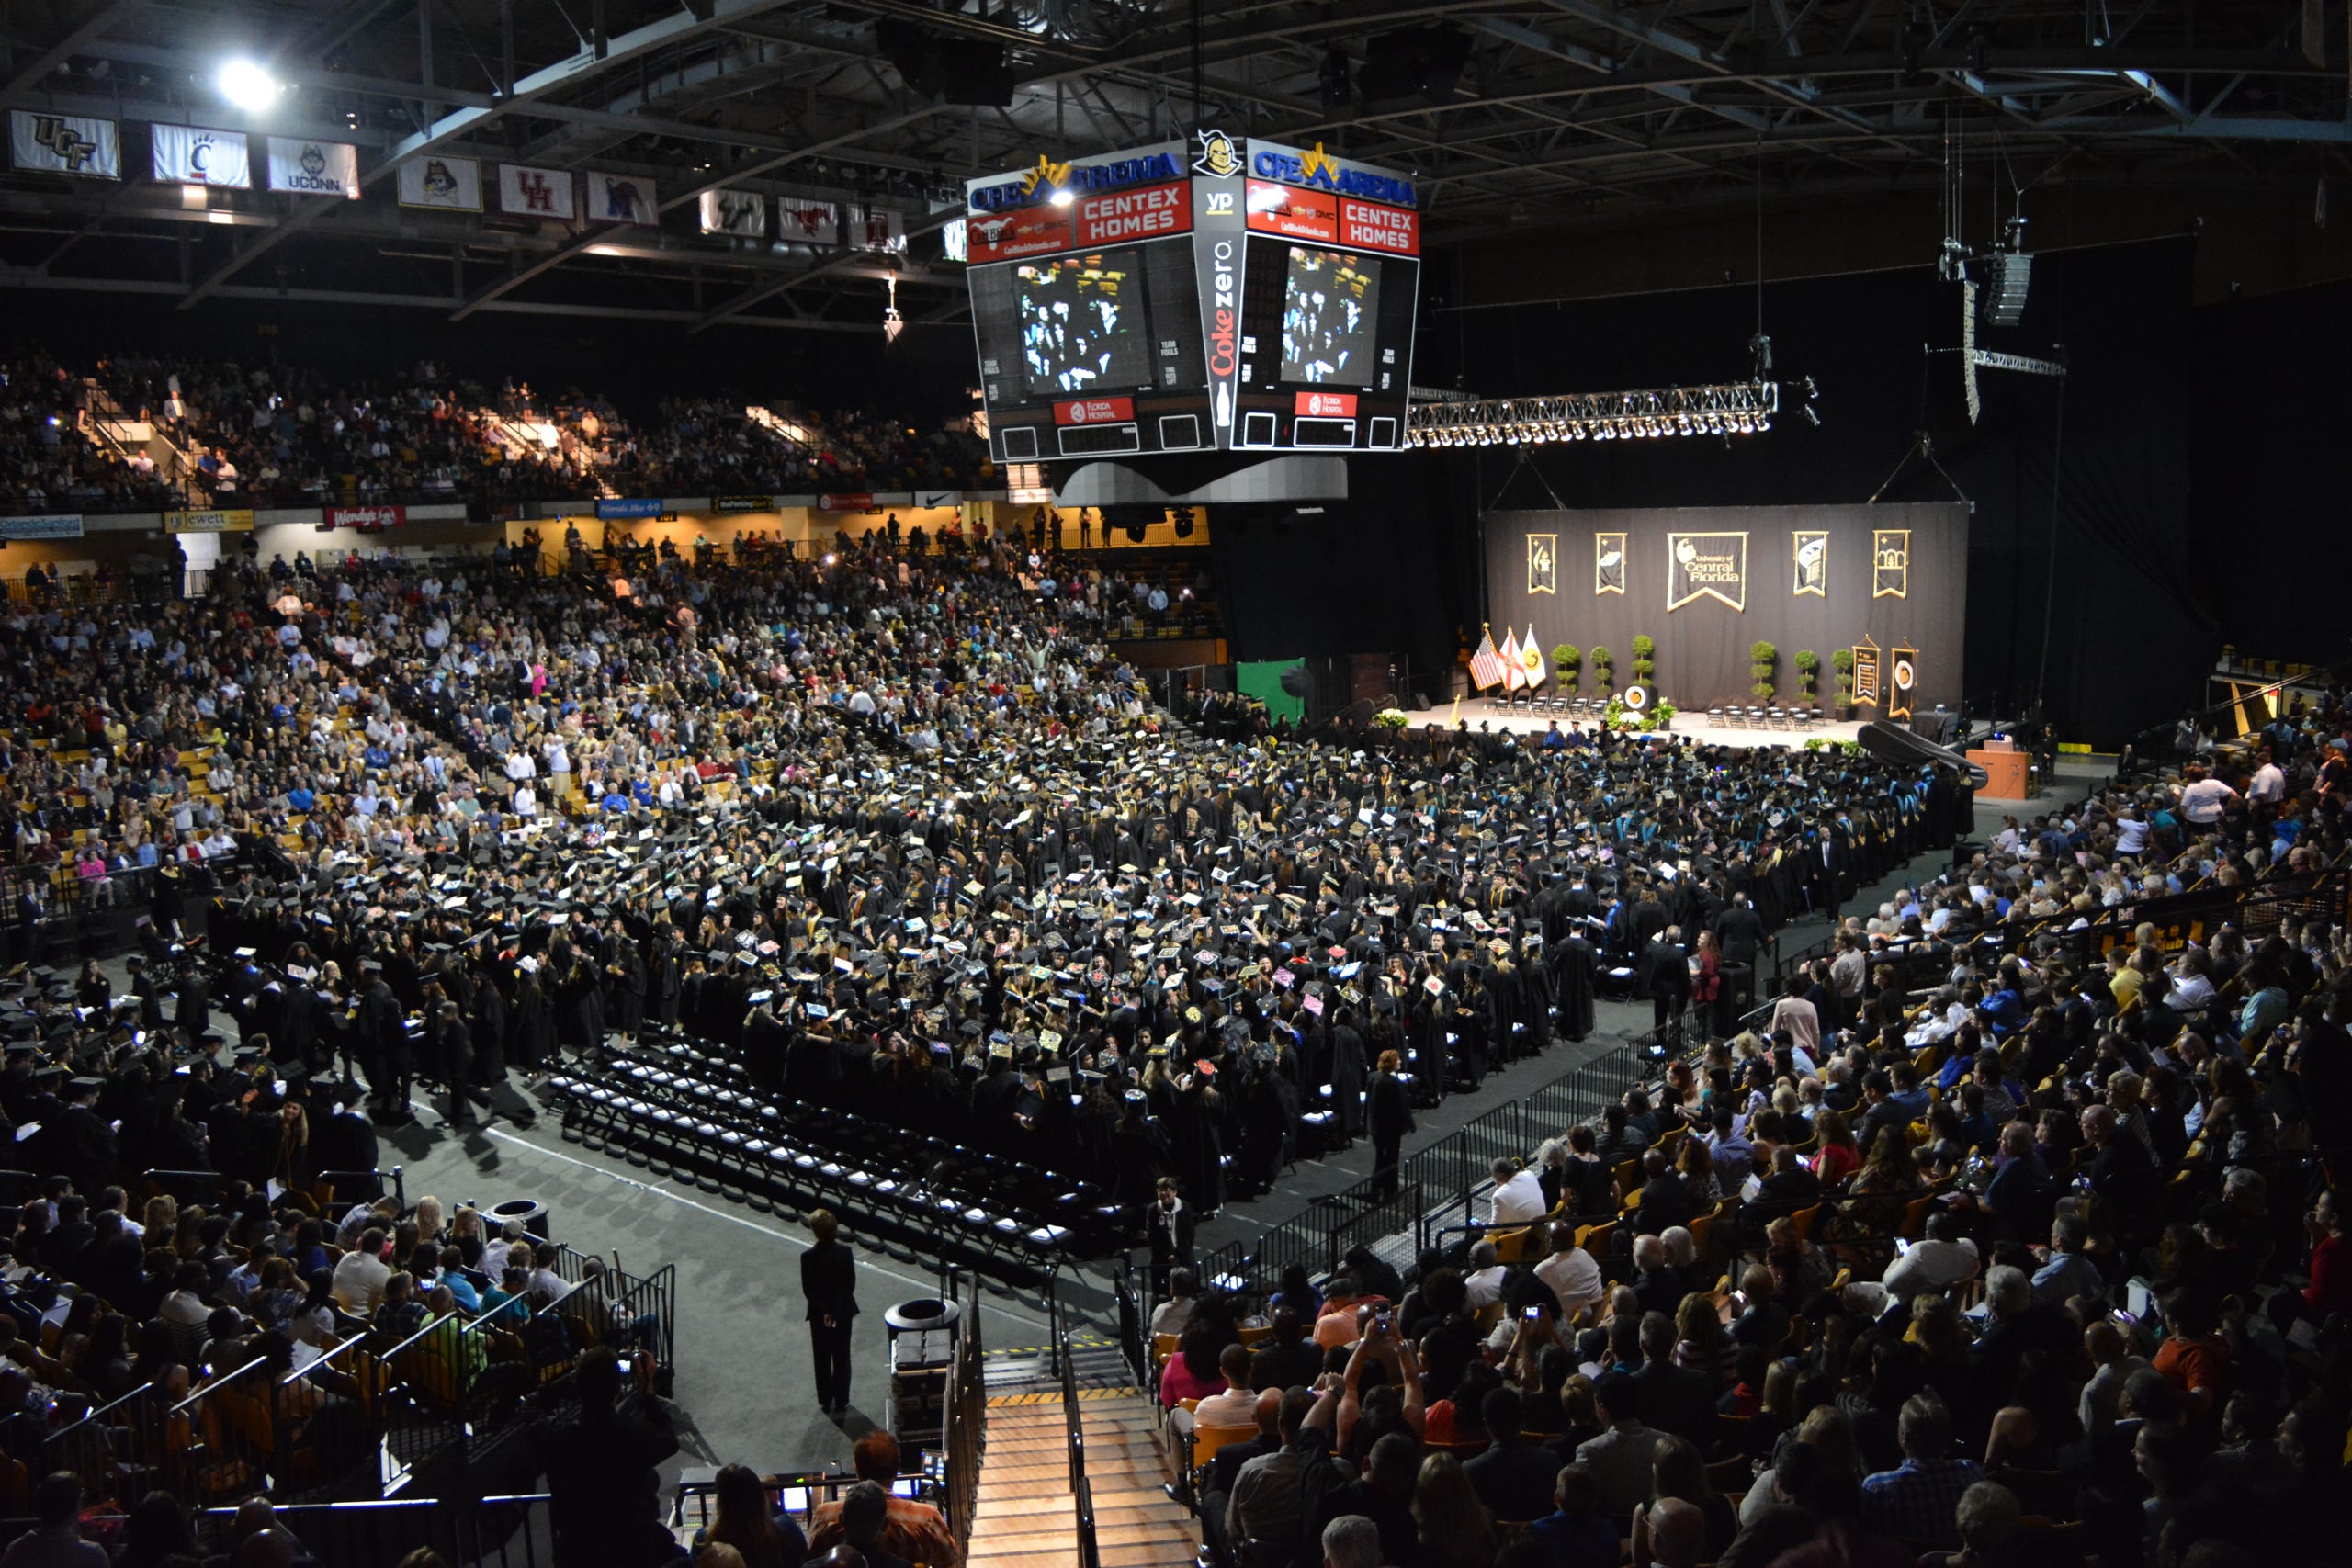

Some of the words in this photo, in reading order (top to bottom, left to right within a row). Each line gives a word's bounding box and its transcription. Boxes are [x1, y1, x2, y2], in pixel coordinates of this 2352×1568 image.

[32, 114, 96, 170] UCF
[1255, 150, 1303, 183] CFE
[288, 175, 340, 192] UCONN
[970, 181, 1022, 210] CFE
[1069, 152, 1182, 189] ARENA
[1084, 187, 1179, 220] CENTEX
[1206, 193, 1233, 211] yp
[1316, 211, 1335, 220] GMC
[1346, 204, 1412, 231] CENTEX
[1090, 210, 1175, 240] HOMES
[1351, 223, 1409, 249] HOMES
[1214, 242, 1233, 308] zero
[1161, 340, 1176, 349] TEAM
[1210, 309, 1235, 376] Coke
[1161, 348, 1179, 356] FOULS
[1087, 402, 1111, 412] FLORIDA
[1322, 404, 1343, 413] HOSPITAL
[1323, 396, 1341, 405] FLORIDA
[1088, 410, 1116, 420] HOSPITAL
[184, 513, 225, 528] Jewett
[334, 506, 377, 526] Wendy's
[1684, 561, 1734, 572] Central
[1696, 555, 1725, 563] University
[1726, 554, 1734, 562] of
[1690, 571, 1739, 582] Florida
